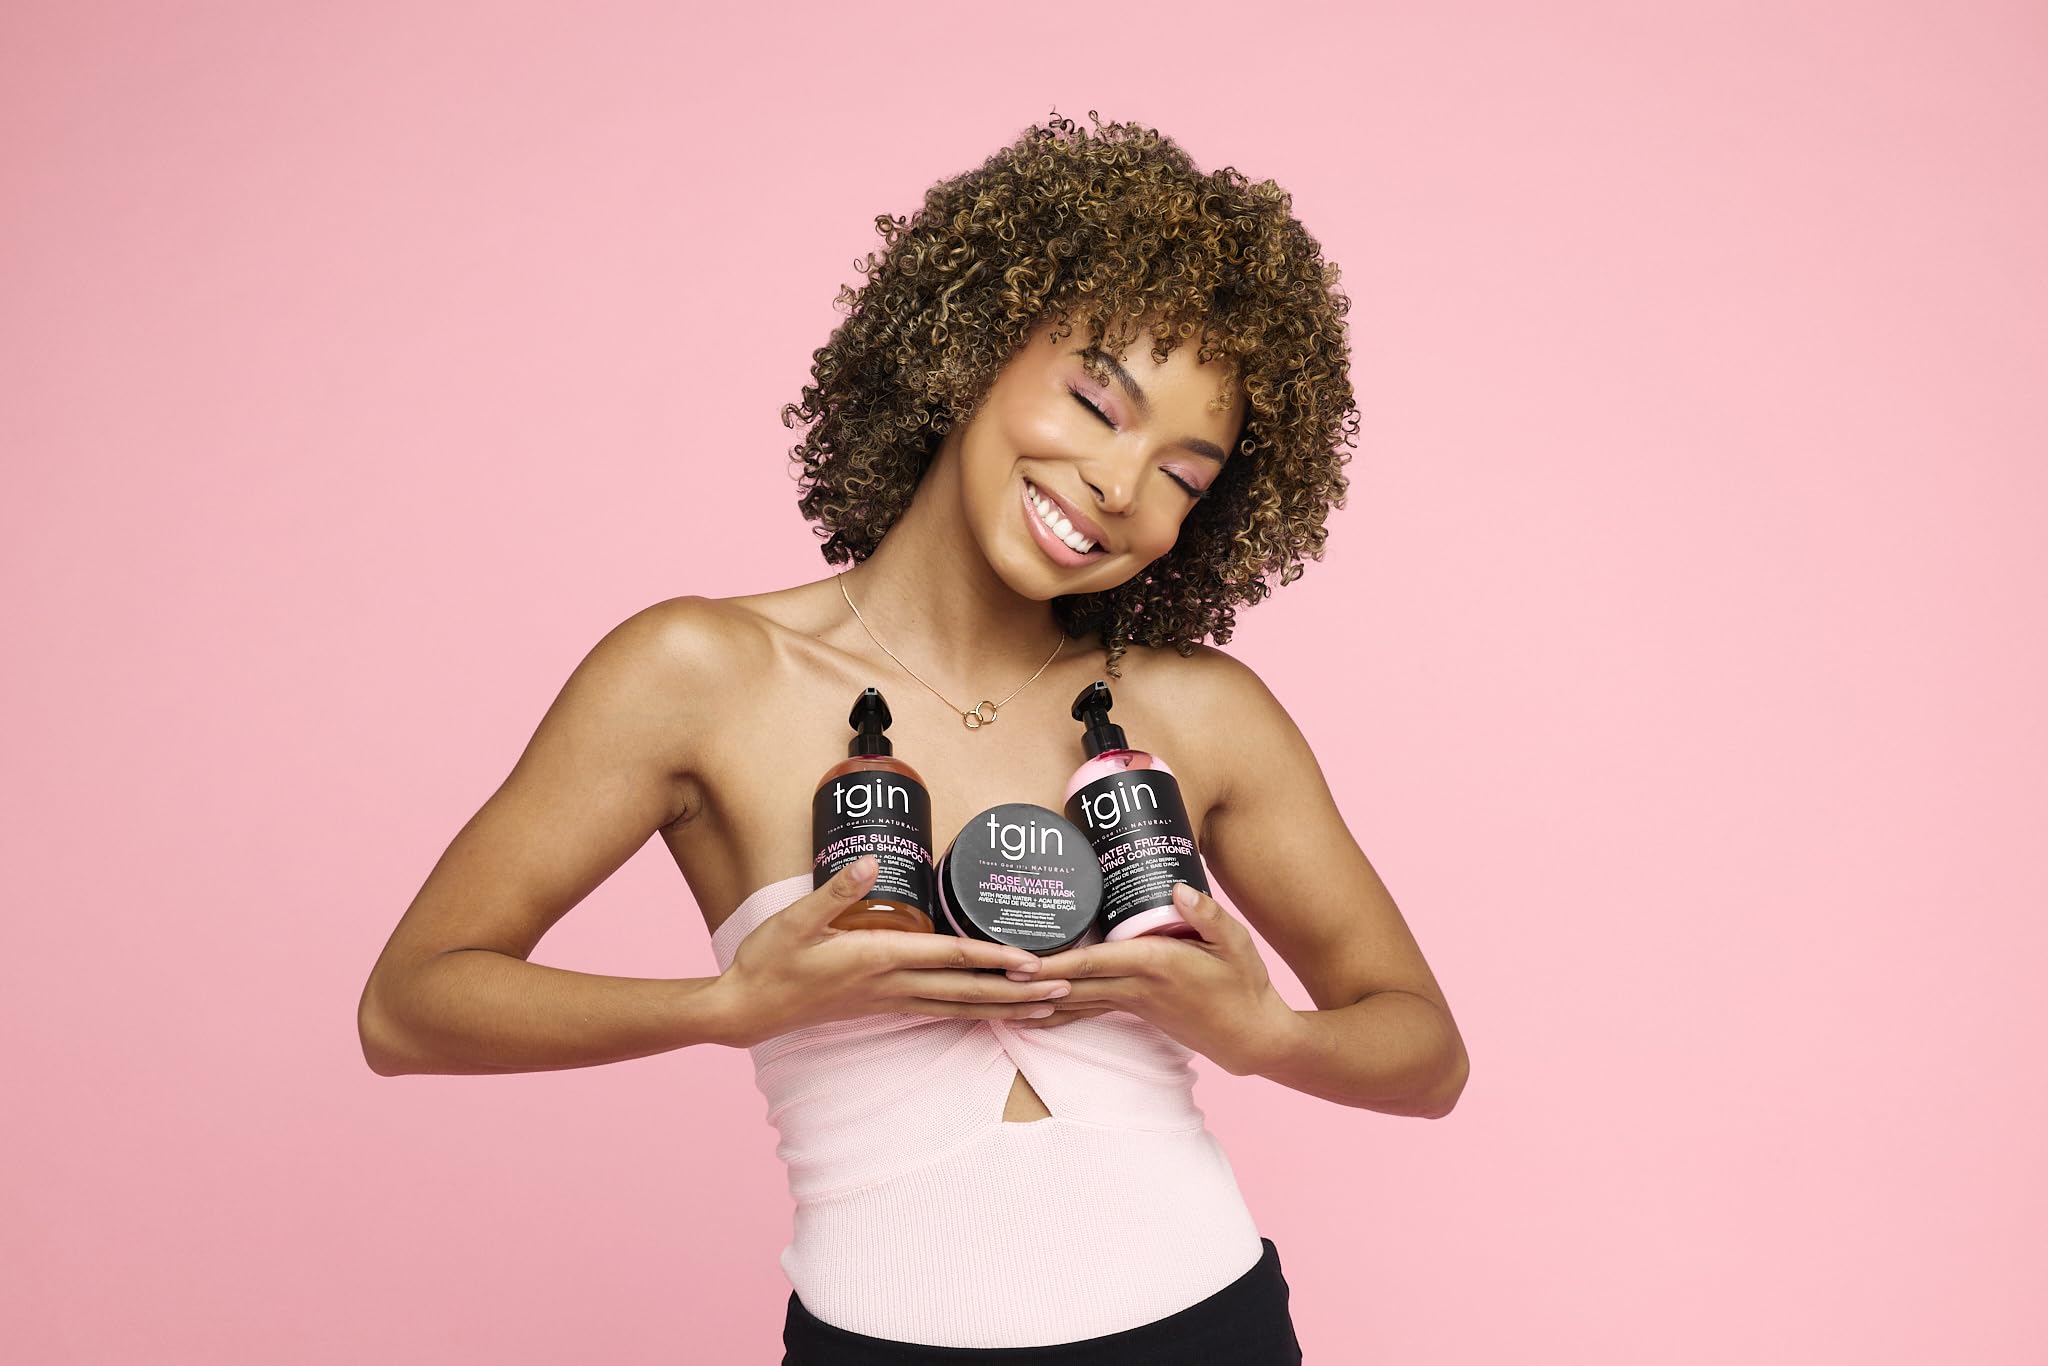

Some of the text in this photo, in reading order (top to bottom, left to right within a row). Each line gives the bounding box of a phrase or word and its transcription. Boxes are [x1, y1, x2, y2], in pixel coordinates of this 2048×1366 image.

[833, 778, 909, 818] tgin
[1081, 781, 1158, 829] tgin
[827, 834, 867, 854] WATER
[869, 833, 919, 853] SULFATE
[986, 813, 1063, 860] tgin
[1134, 836, 1169, 850] FRIZZ
[1170, 836, 1194, 850] FREE
[821, 843, 874, 867] HYDRATING
[876, 843, 924, 864] SHAMPOO
[1127, 845, 1192, 861] CONDITIONER
[1122, 862, 1140, 873] WATER
[1129, 866, 1145, 876] ROSE
[979, 881, 1075, 898] HYDRATING HAIR MASK
[989, 873, 1064, 890] ROSE WATER
[1011, 894, 1032, 902] WATER
[1020, 900, 1036, 908] ROSE
